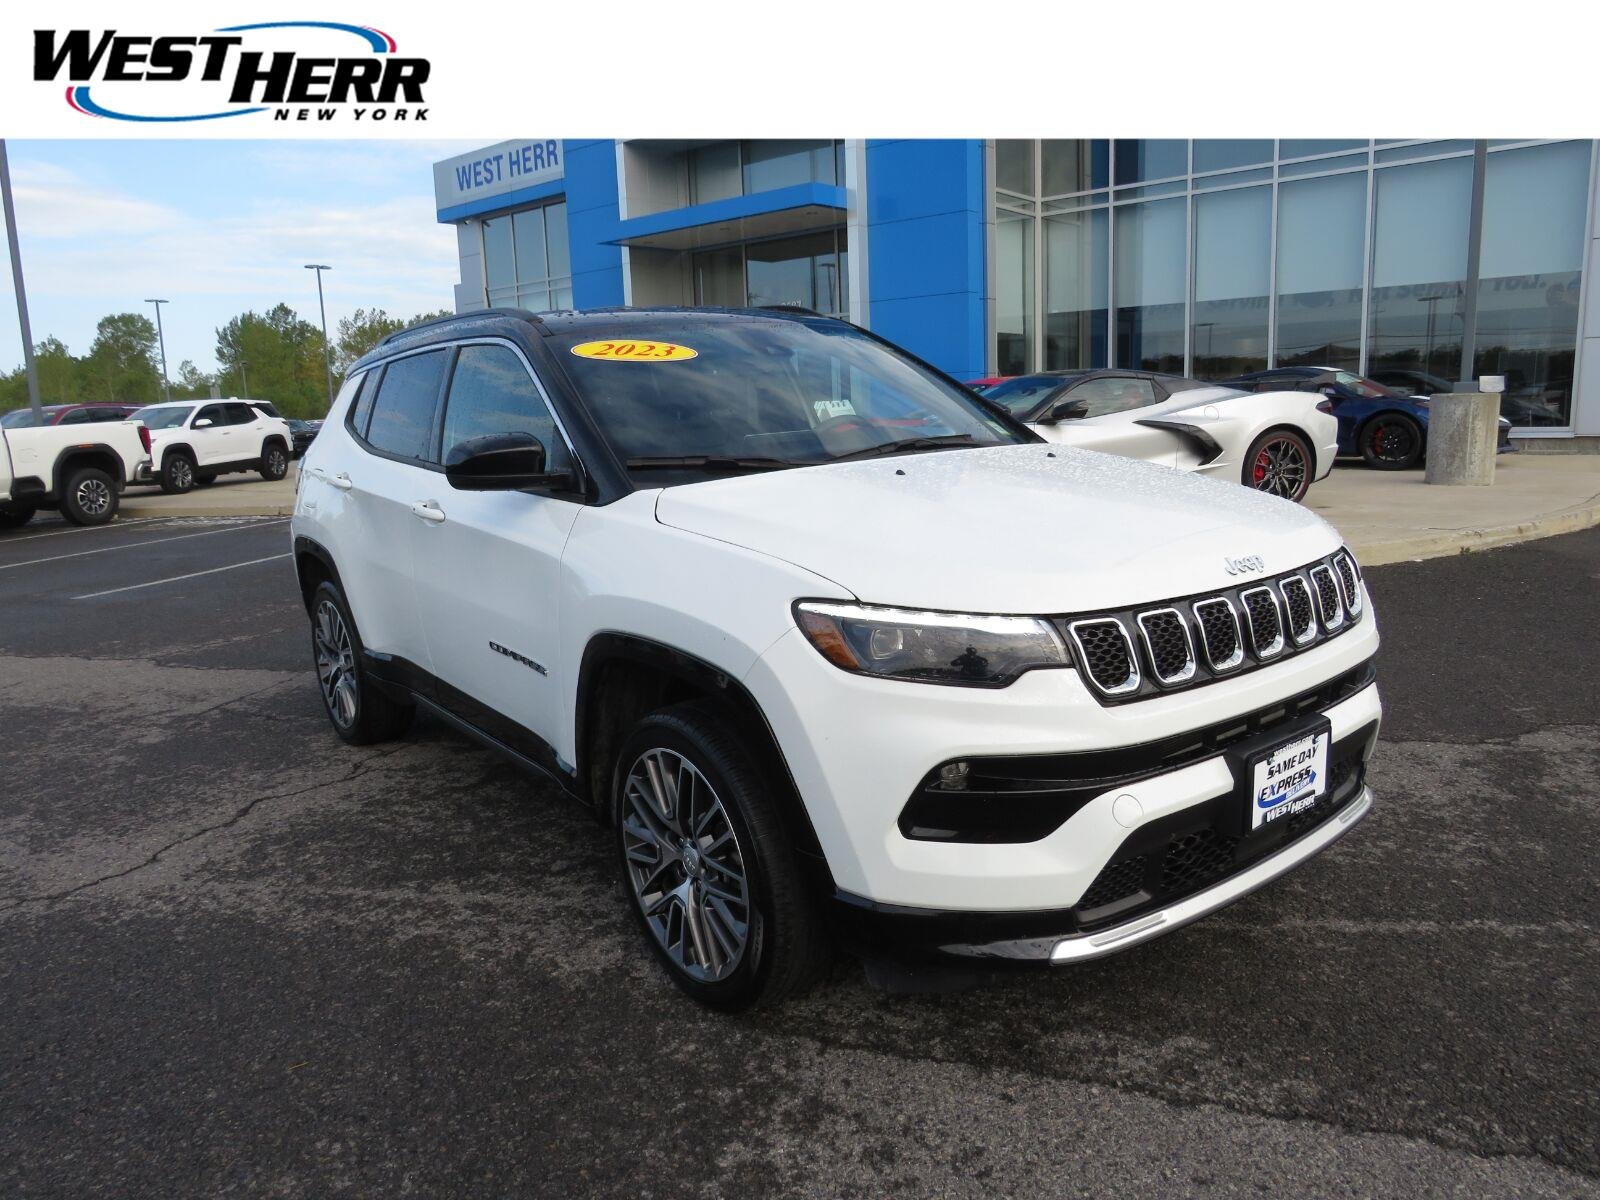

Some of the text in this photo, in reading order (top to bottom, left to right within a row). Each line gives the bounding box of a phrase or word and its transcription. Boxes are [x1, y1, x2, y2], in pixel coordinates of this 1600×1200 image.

[456, 139, 559, 191] WEST HERR
[592, 343, 676, 357] 2023
[1224, 554, 1264, 576] Jeep
[1266, 745, 1319, 780] SAME DAY
[1260, 765, 1312, 801] EXPRESS
